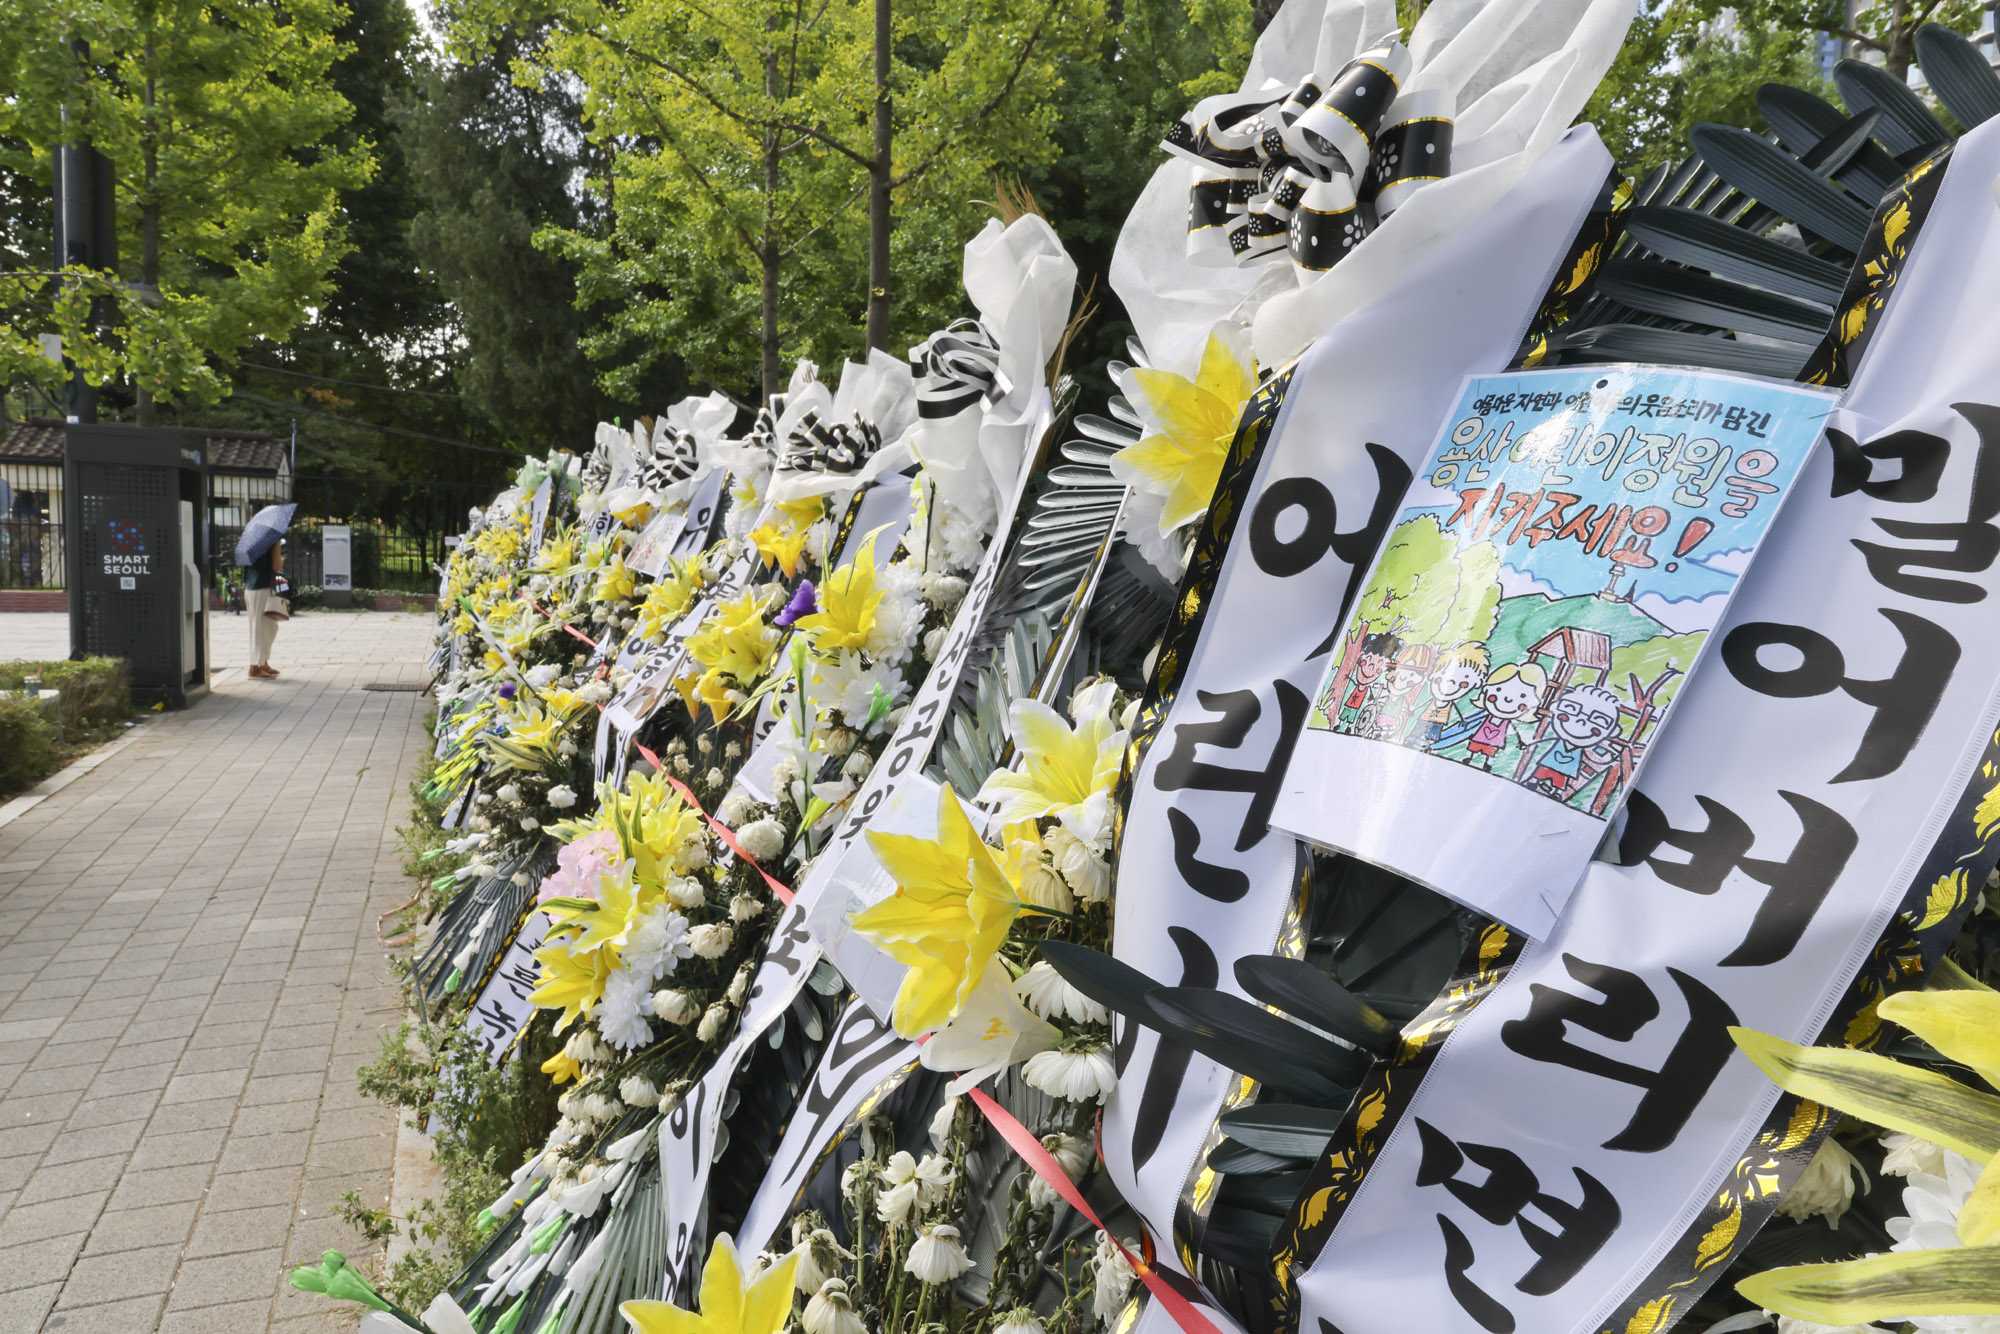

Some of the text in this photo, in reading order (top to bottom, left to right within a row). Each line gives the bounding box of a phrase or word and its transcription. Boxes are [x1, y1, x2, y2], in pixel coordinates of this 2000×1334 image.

[1473, 393, 1515, 416] 아름다운
[1514, 392, 1562, 413] 자연과
[1638, 394, 1723, 424] 웃음소리가
[1721, 406, 1772, 438] 담긴
[1431, 416, 1780, 518] 용산어린이정원을
[103, 554, 150, 564] SMART
[103, 564, 151, 575] SEOUL
